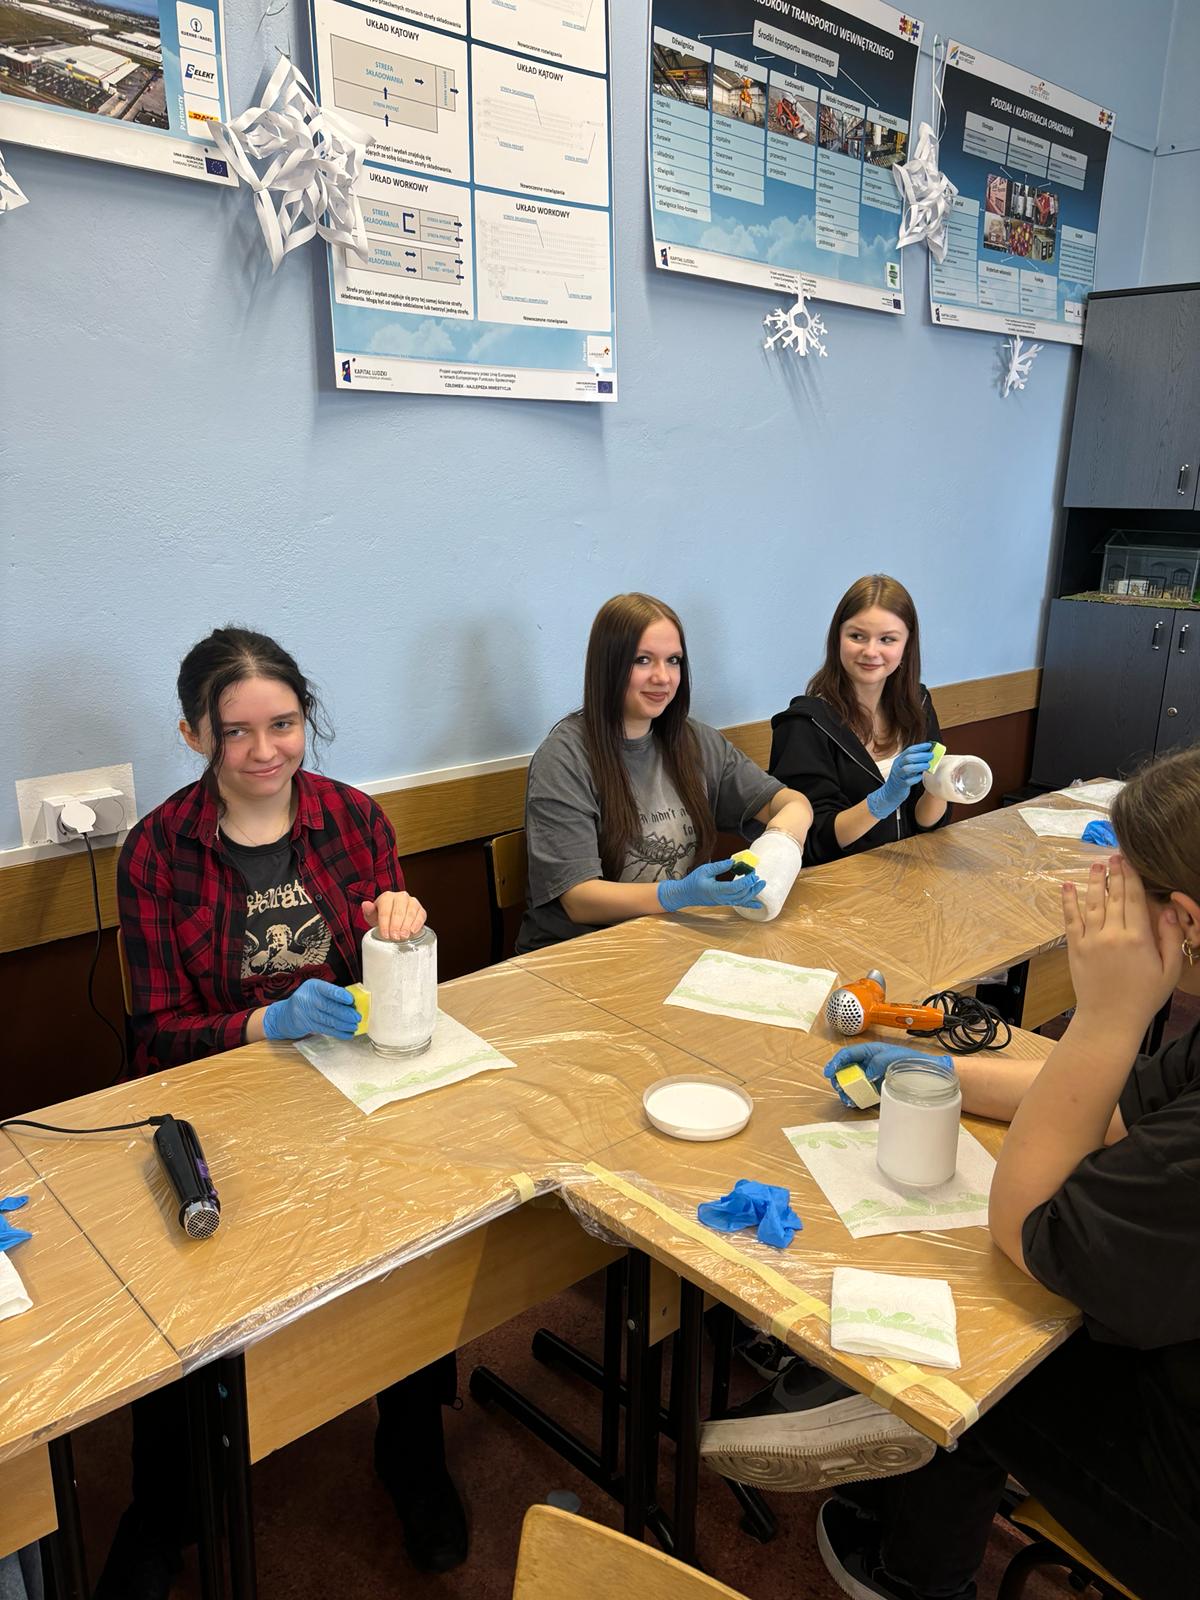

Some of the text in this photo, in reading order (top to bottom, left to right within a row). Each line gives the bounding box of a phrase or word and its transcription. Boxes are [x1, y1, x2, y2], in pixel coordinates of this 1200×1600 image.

[365, 18, 420, 42] UKŁAD KĄTOWY
[791, 6, 838, 36] TRANSPORTU
[839, 26, 895, 61] WEWNĘTRZNEGO
[516, 40, 540, 52] Nowoczesne
[672, 36, 694, 52] Dźwignice
[758, 27, 835, 68] Środki transportu wewnętrznego
[186, 64, 215, 80] SELEKT
[375, 61, 394, 73] STREFA
[516, 62, 564, 82] UKŁAD KĄTOWY
[365, 68, 404, 86] SKŁADOWANIA
[990, 96, 1013, 114] PODZIAŁ
[1016, 105, 1048, 127] KLASYFIKACJA
[1048, 117, 1075, 138] OPAKOWAŃ
[394, 147, 408, 156] wydań
[369, 172, 429, 193] UKŁAD WORKOWY
[520, 182, 543, 192] Nowoczesne
[372, 208, 390, 218] STREFA
[516, 203, 536, 213] UKŁAD
[537, 206, 570, 219] WORKOWY
[374, 248, 392, 257] STREFA
[368, 256, 401, 268] KŁADOWANIA
[346, 286, 358, 294] Strefa
[354, 368, 372, 376] KAPITAŁ
